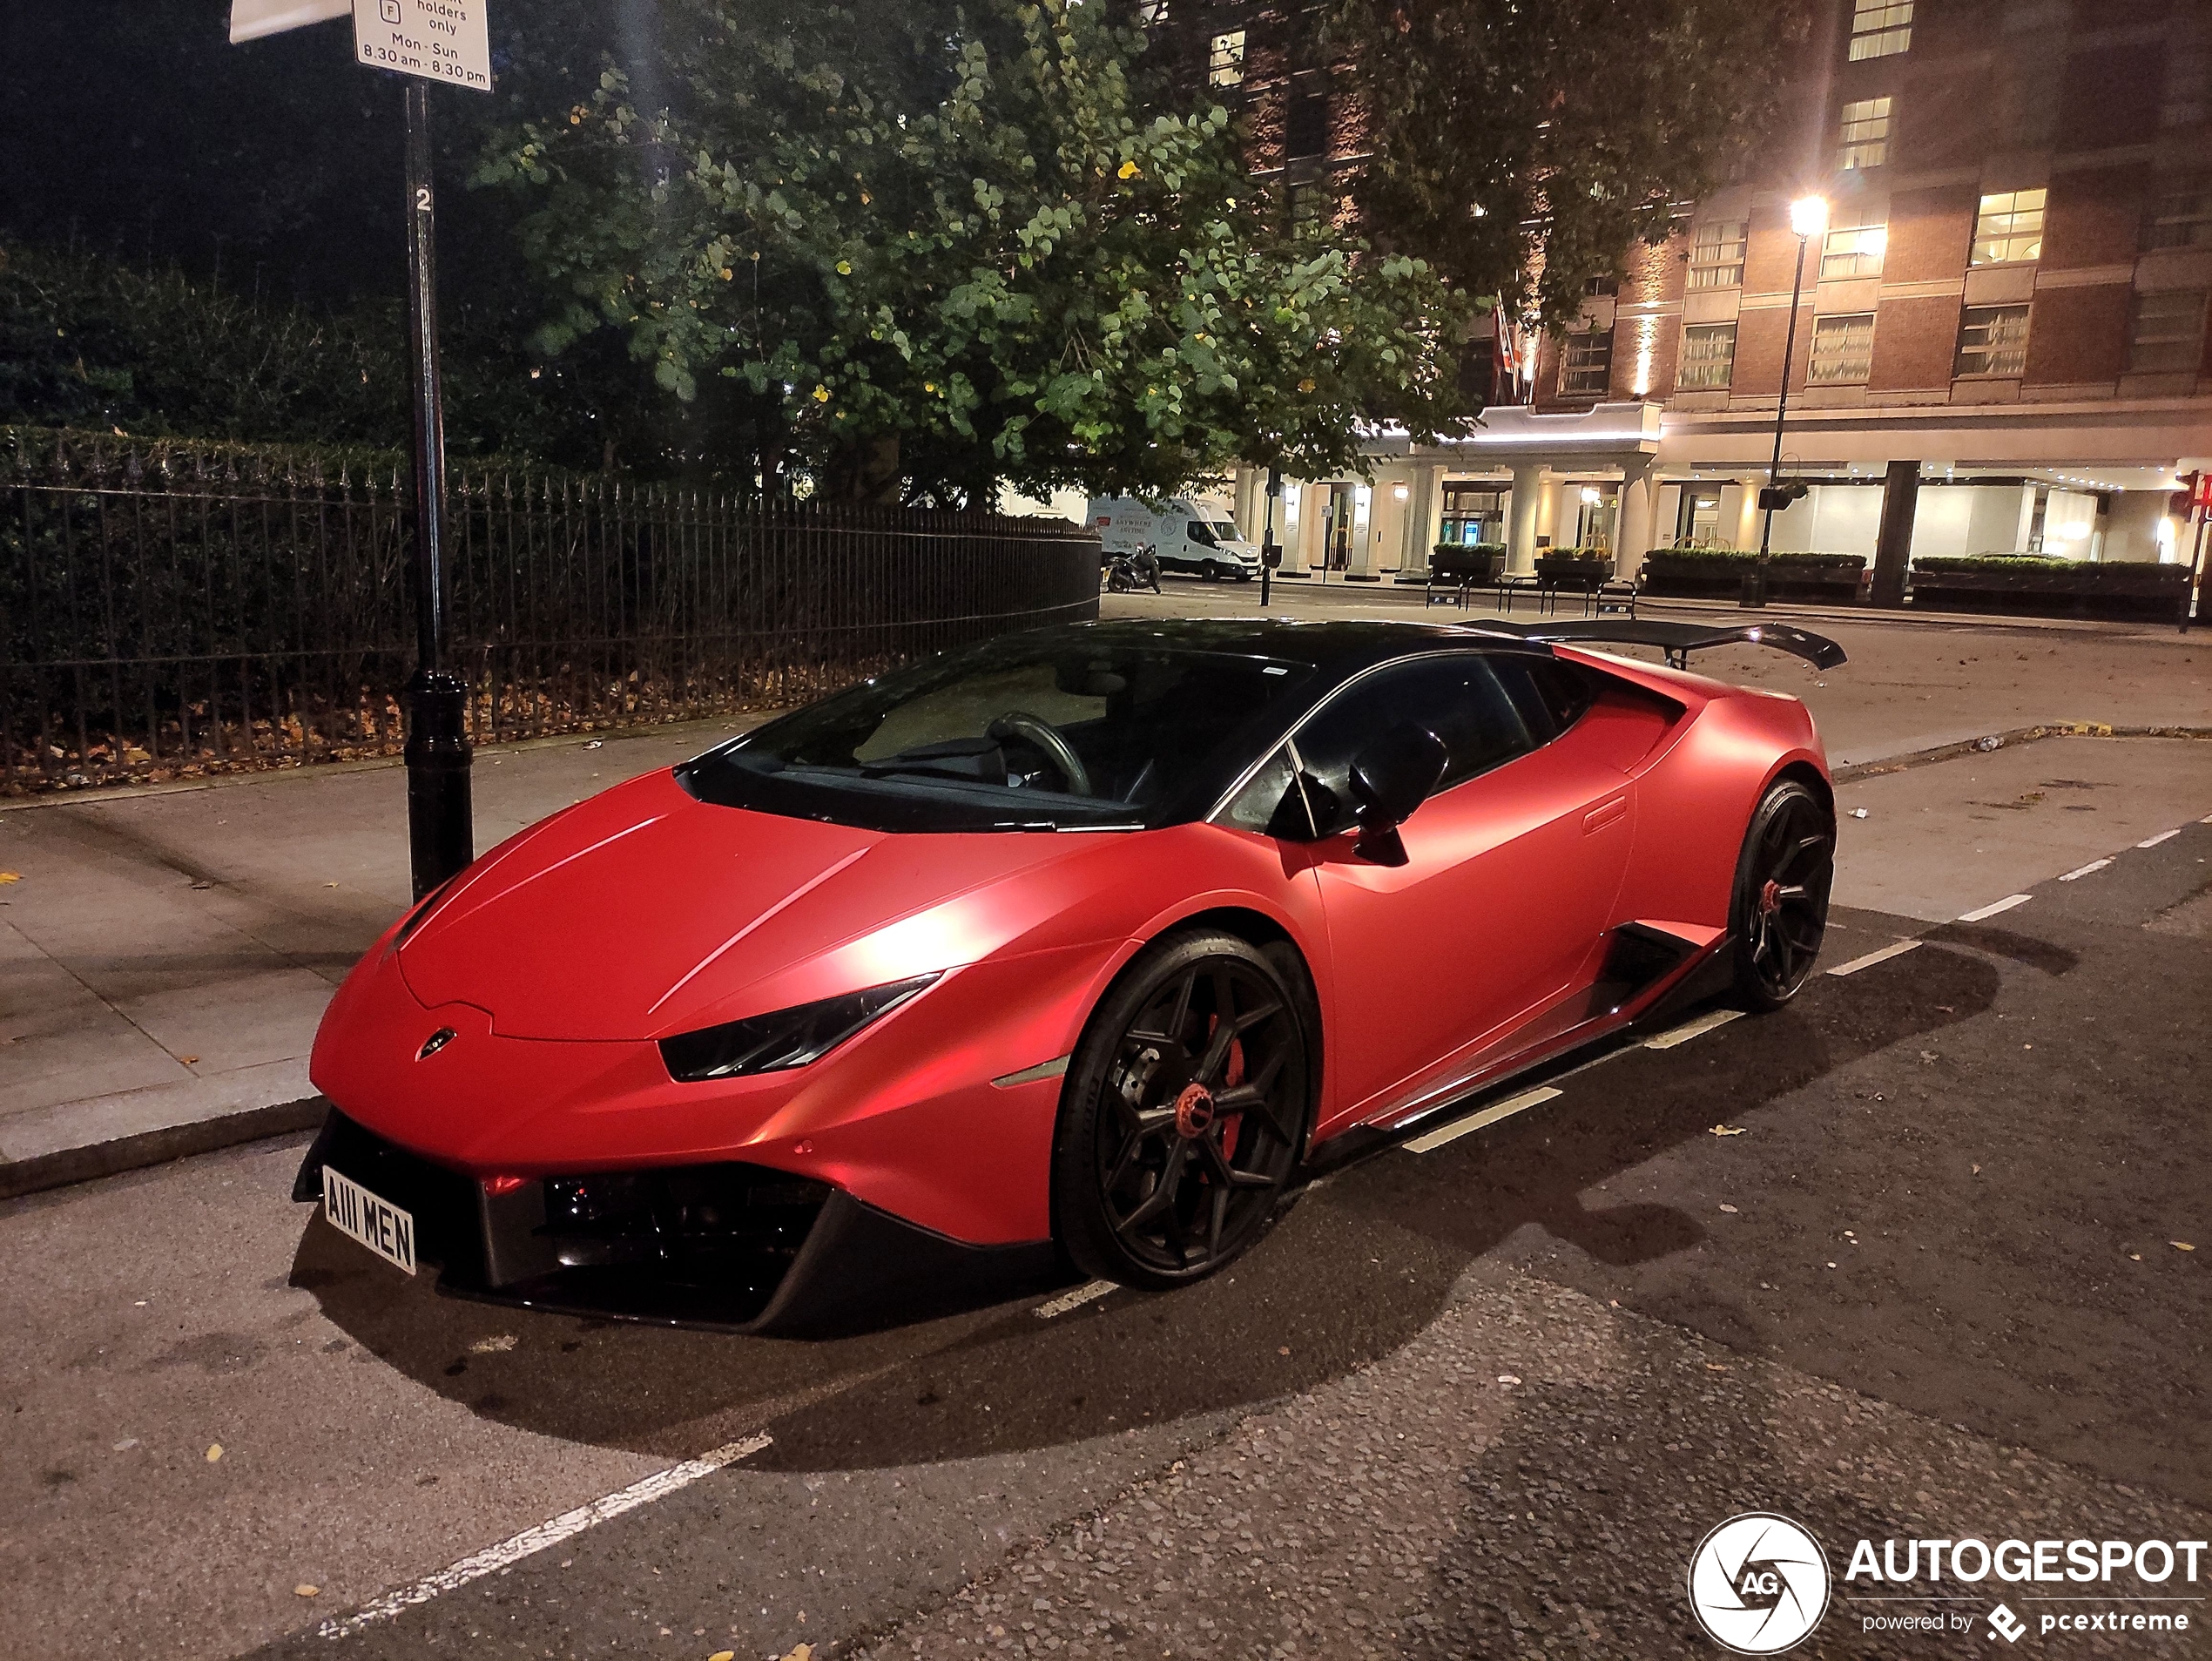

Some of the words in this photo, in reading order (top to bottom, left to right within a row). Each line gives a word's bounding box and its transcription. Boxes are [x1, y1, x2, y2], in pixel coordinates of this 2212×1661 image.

[417, 0, 467, 21] holders
[429, 20, 456, 36] only
[392, 32, 421, 51] Mon
[433, 43, 458, 59] Sun
[364, 44, 397, 63] 8.30
[401, 56, 421, 68] am
[433, 61, 463, 78] 8.30
[467, 71, 486, 83] pm
[416, 189, 431, 211] 2
[362, 1196, 411, 1266] MEN
